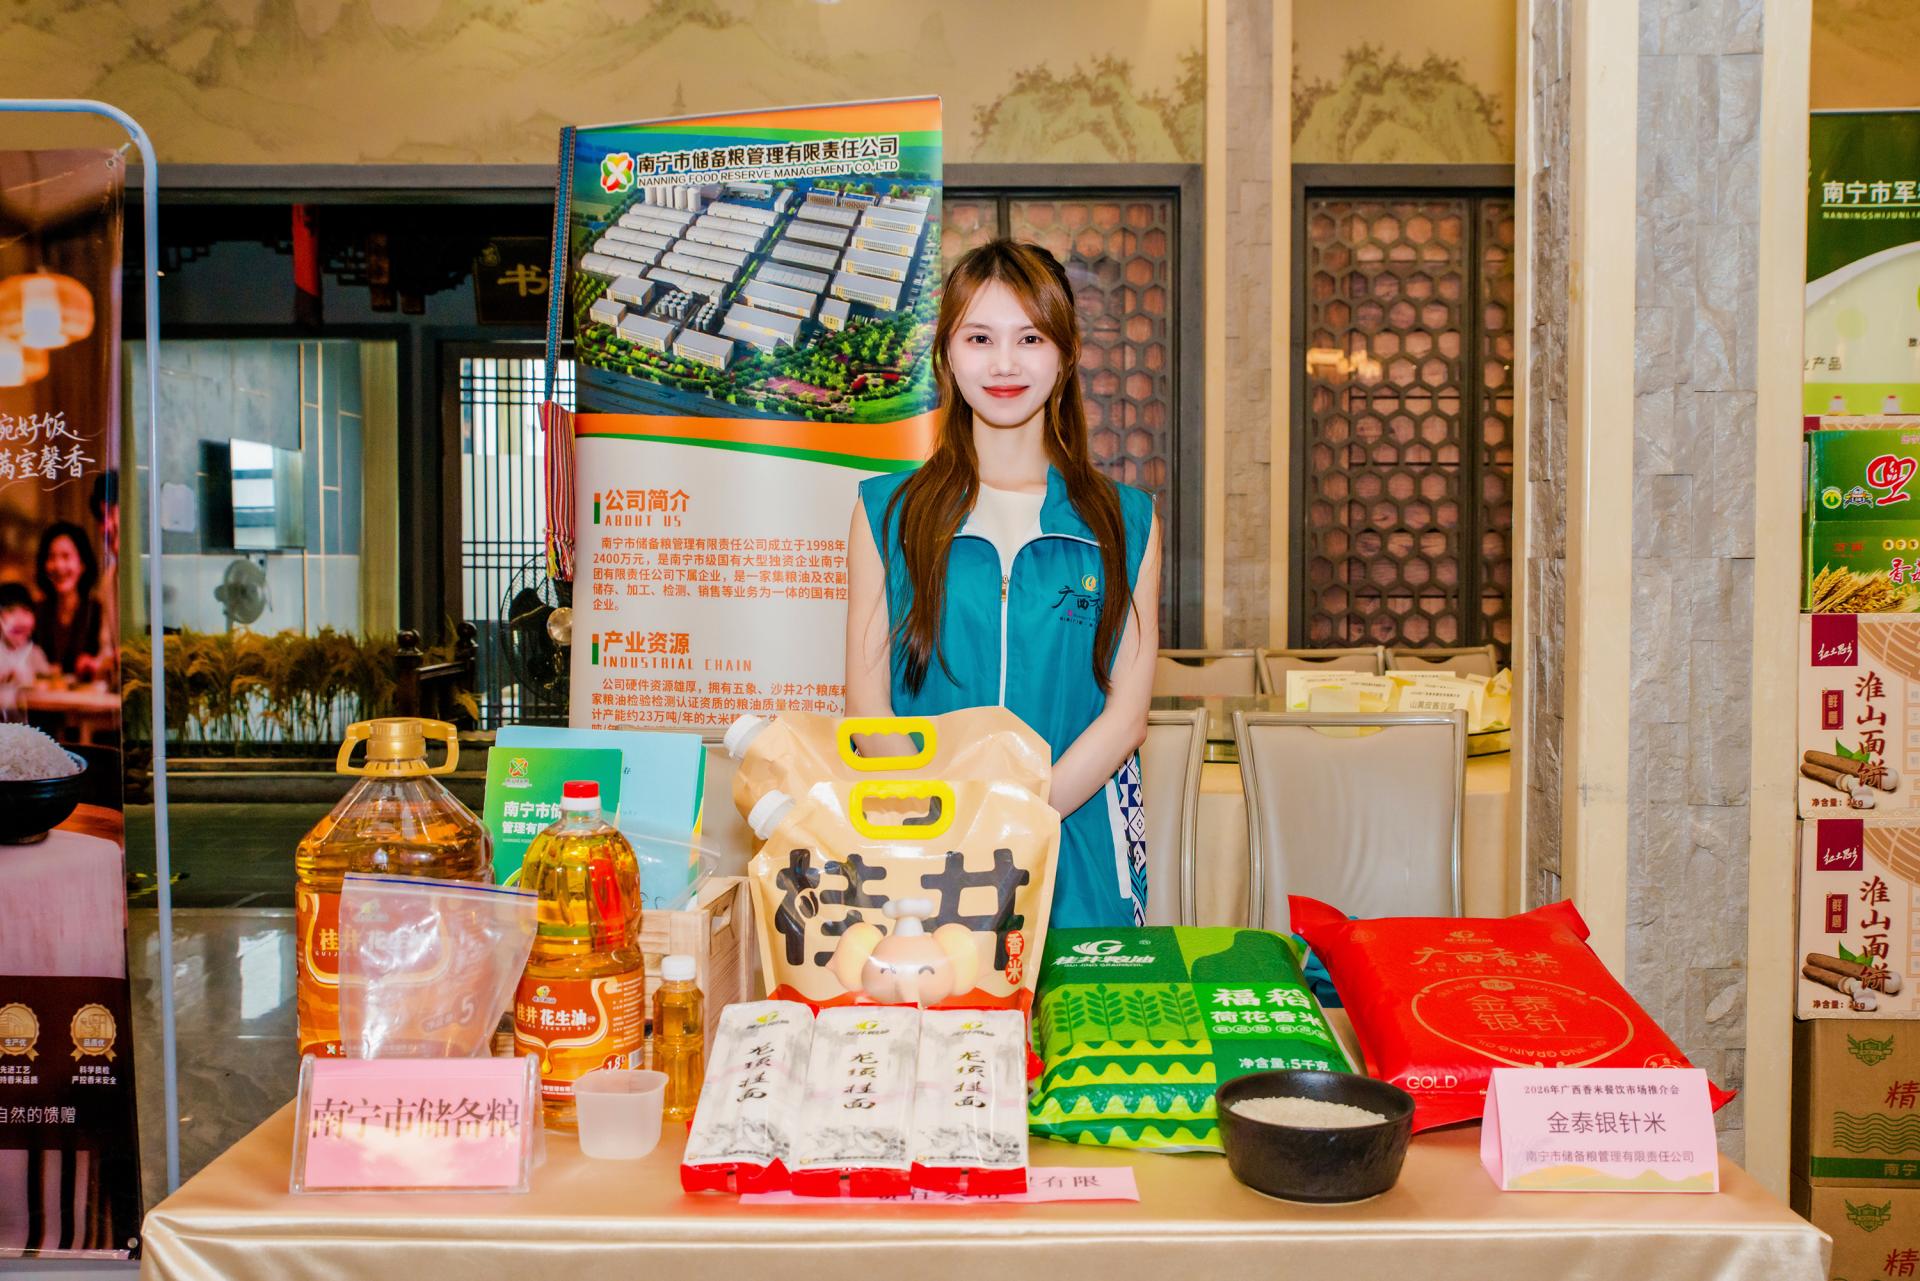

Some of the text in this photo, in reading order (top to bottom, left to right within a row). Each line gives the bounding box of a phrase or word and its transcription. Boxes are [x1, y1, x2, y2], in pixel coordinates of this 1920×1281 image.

[638, 137, 898, 173] 南宁市储备粮管理有限责任公司
[638, 174, 687, 187] NANNING
[688, 173, 719, 183] FOOD
[720, 169, 771, 182] RESERVE
[773, 164, 851, 178] MANAGEMENT
[1822, 180, 1920, 204] 南宁市军
[496, 263, 549, 297] 书
[605, 489, 690, 512] 公司简介
[605, 515, 682, 527] ABOUT US
[601, 536, 846, 552] 南宁市储备粮管理有限责任公司成立于1998年
[593, 552, 849, 569] 2400万元，是南宁市级国有大型独资企业南宁
[603, 630, 690, 655] 产业资源
[603, 656, 752, 672] INDUSTRIAL CHAIN
[1855, 671, 1888, 791] 淮山面饼
[1859, 875, 1891, 994] 淮山面饼
[1007, 932, 1023, 982] 香米
[1212, 988, 1312, 1010] 福稻
[1466, 995, 1557, 1012] 金泰
[540, 1008, 587, 1026] 花生油
[1210, 1011, 1325, 1031] 荷花香米
[1476, 1013, 1570, 1032] 银针
[1407, 1075, 1458, 1089] GOLD
[1524, 1084, 1680, 1096] 2026年广西香米餐饮市场推介会
[1884, 1080, 1920, 1109] 精
[312, 1097, 519, 1138] 南宁市储备粮
[1547, 1111, 1667, 1135] 金泰银针米
[1526, 1149, 1695, 1163] 南宁市储备粮管理有限责任公司
[1030, 1174, 1101, 1188] 有限
[1884, 1163, 1918, 1177] 南宁
[1884, 1247, 1920, 1278] 精
